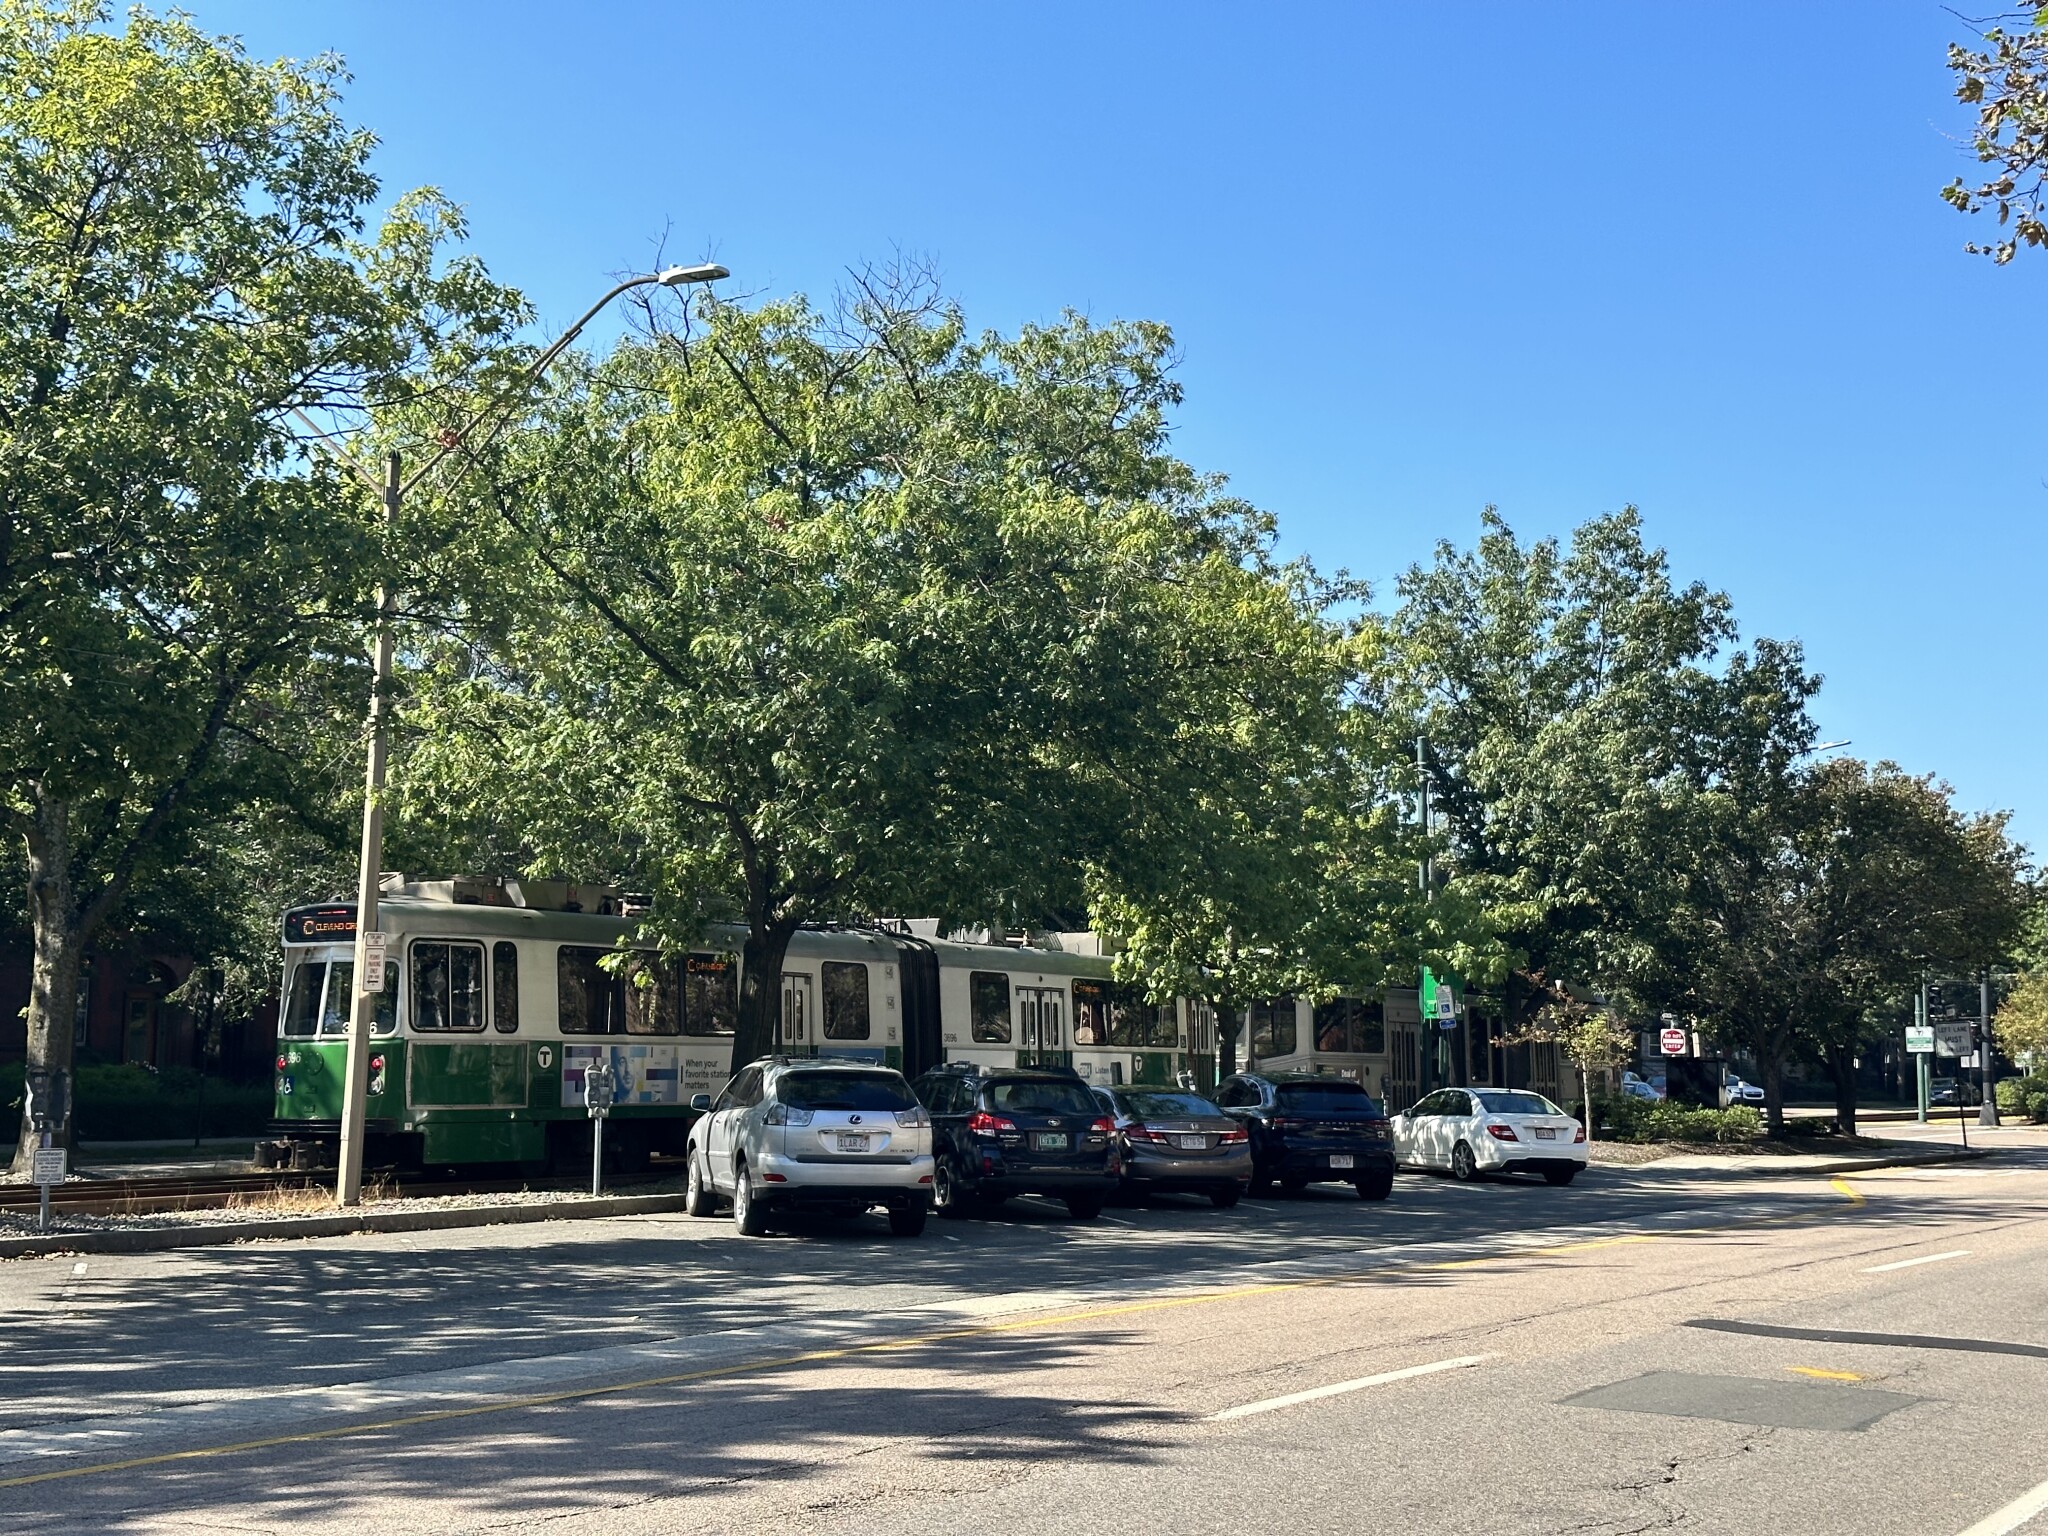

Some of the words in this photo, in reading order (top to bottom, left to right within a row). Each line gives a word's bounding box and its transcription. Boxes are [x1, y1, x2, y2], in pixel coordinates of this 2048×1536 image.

[303, 920, 314, 935] C
[1945, 1035, 1962, 1043] MUST
[685, 1059, 703, 1067] When
[703, 1060, 718, 1069] your
[685, 1069, 709, 1078] favorite
[710, 1070, 731, 1078] station
[684, 1081, 710, 1089] matters
[839, 1138, 858, 1148] 1LAR
